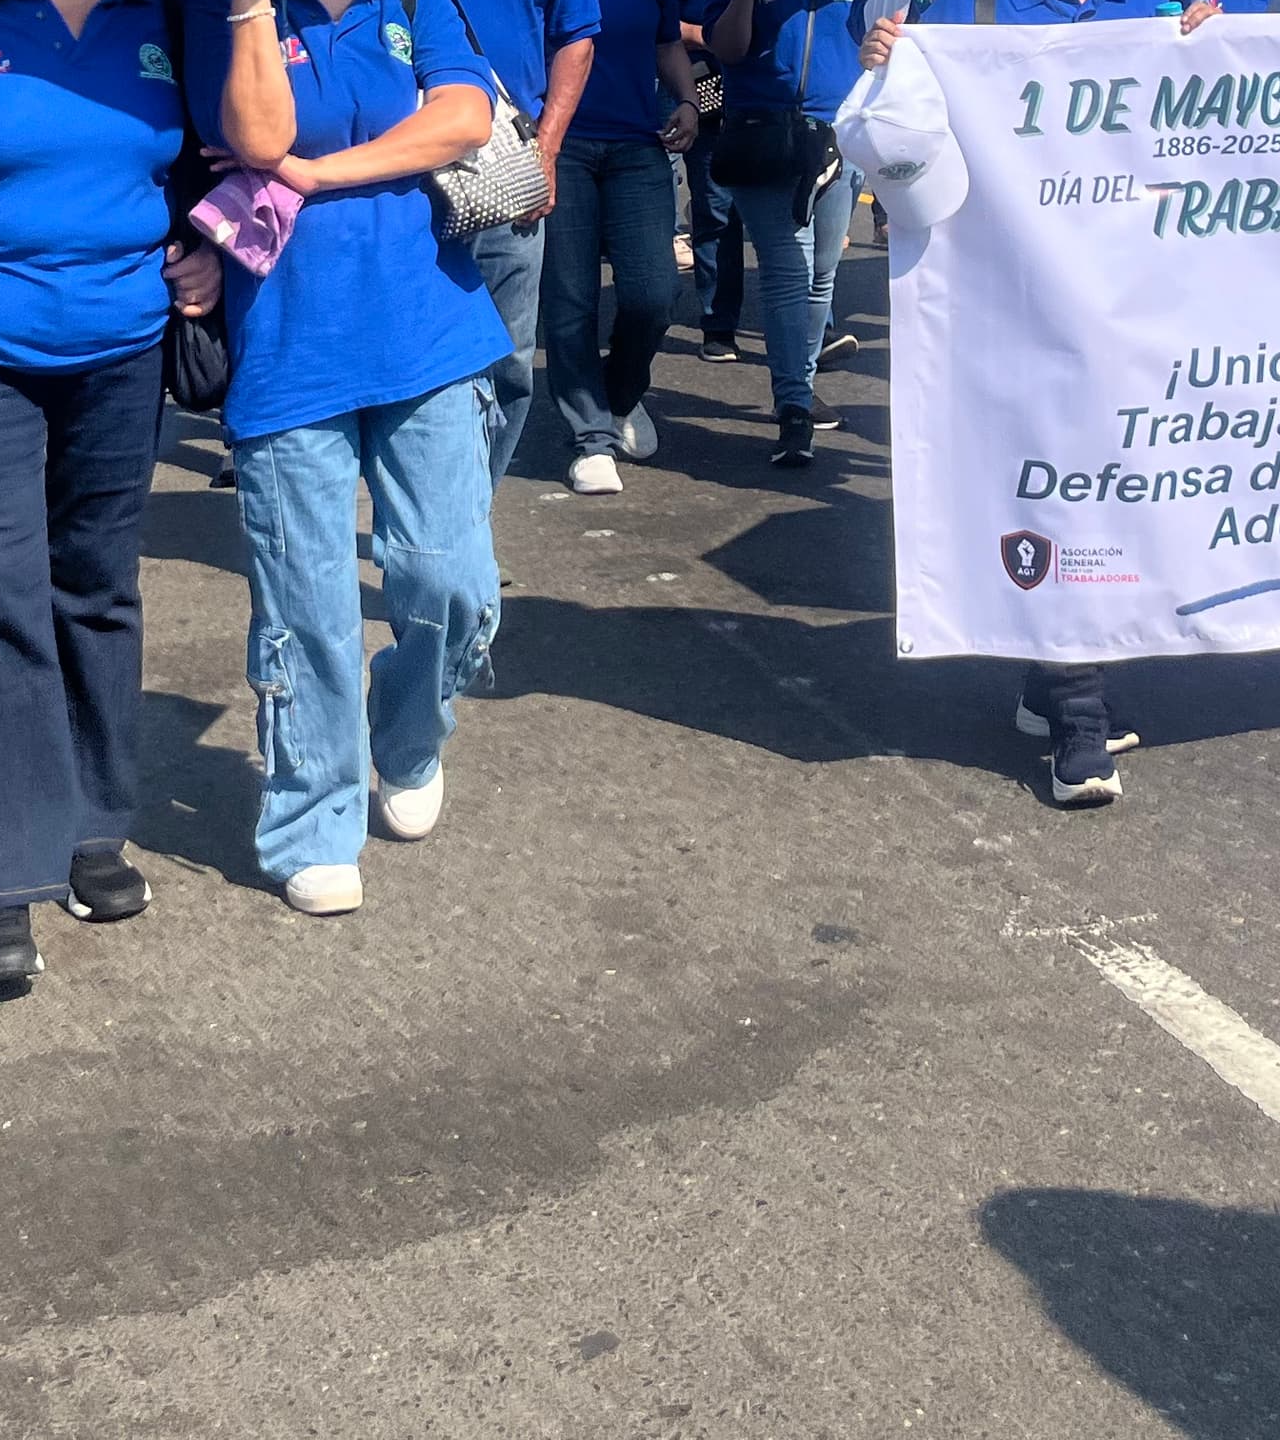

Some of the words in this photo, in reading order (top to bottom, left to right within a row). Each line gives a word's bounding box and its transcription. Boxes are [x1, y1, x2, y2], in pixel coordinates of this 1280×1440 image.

[1013, 79, 1045, 138] 1
[1065, 76, 1142, 136] DE
[1038, 170, 1082, 206] DÍA
[1091, 174, 1140, 204] DEL
[1016, 459, 1234, 503] Defensa
[1060, 546, 1123, 557] ASOCIACIÓN
[1060, 558, 1106, 567] GENERAL
[1017, 567, 1036, 576] AGT
[1061, 574, 1140, 583] TRABAJADORES
